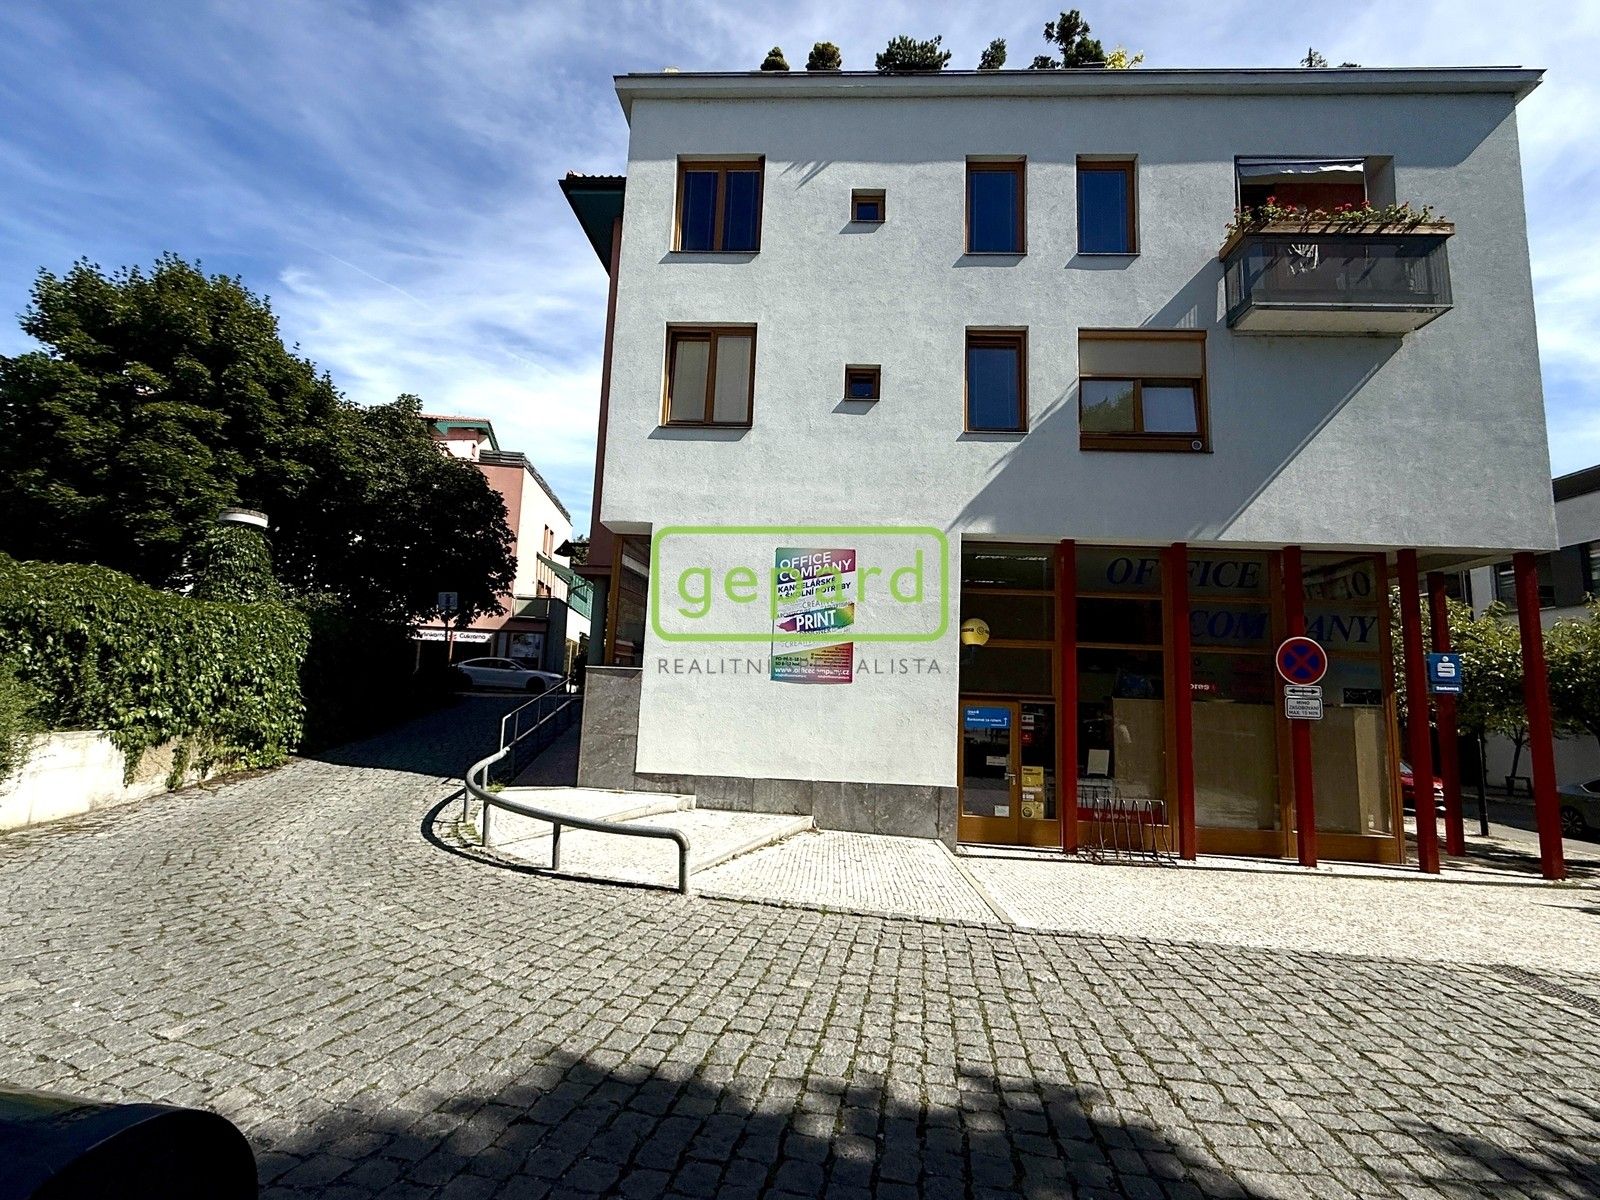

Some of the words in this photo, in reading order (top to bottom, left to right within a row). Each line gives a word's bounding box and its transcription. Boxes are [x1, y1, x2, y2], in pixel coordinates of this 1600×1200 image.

[779, 558, 852, 582] COMPANY
[780, 551, 832, 569] OFFICE
[795, 609, 836, 632] PRINT
[1190, 610, 1379, 642] COMANY
